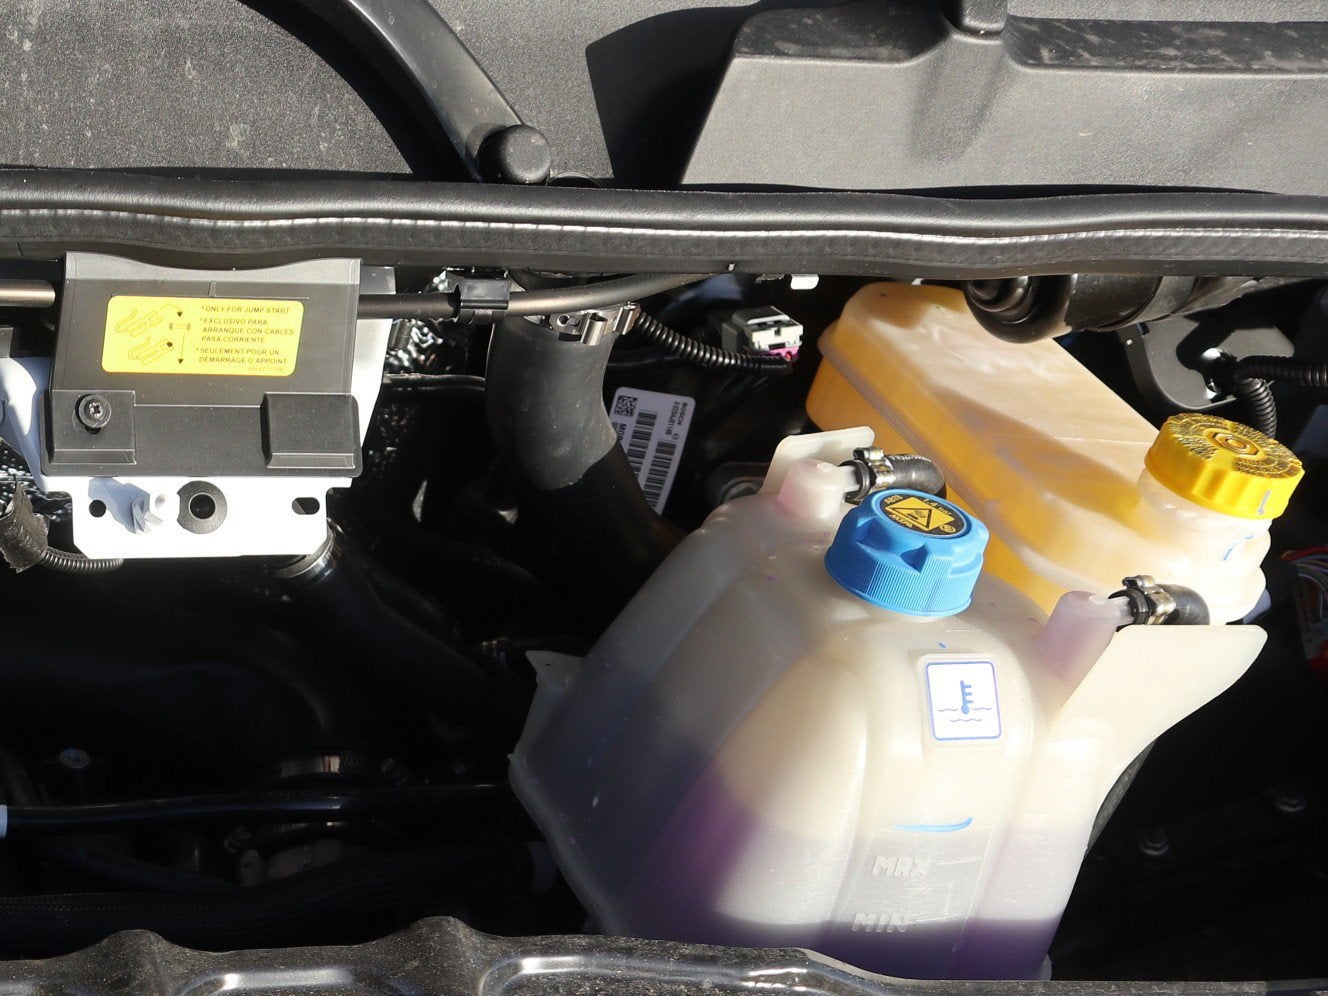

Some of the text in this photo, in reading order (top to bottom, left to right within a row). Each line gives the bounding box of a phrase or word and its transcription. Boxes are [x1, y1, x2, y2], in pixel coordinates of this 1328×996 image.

[266, 307, 290, 315] START
[202, 326, 245, 334] ARRANQUE
[264, 328, 294, 336] CABLES
[246, 348, 267, 356] POUR
[872, 856, 929, 877] MAX
[852, 913, 909, 933] MIN
